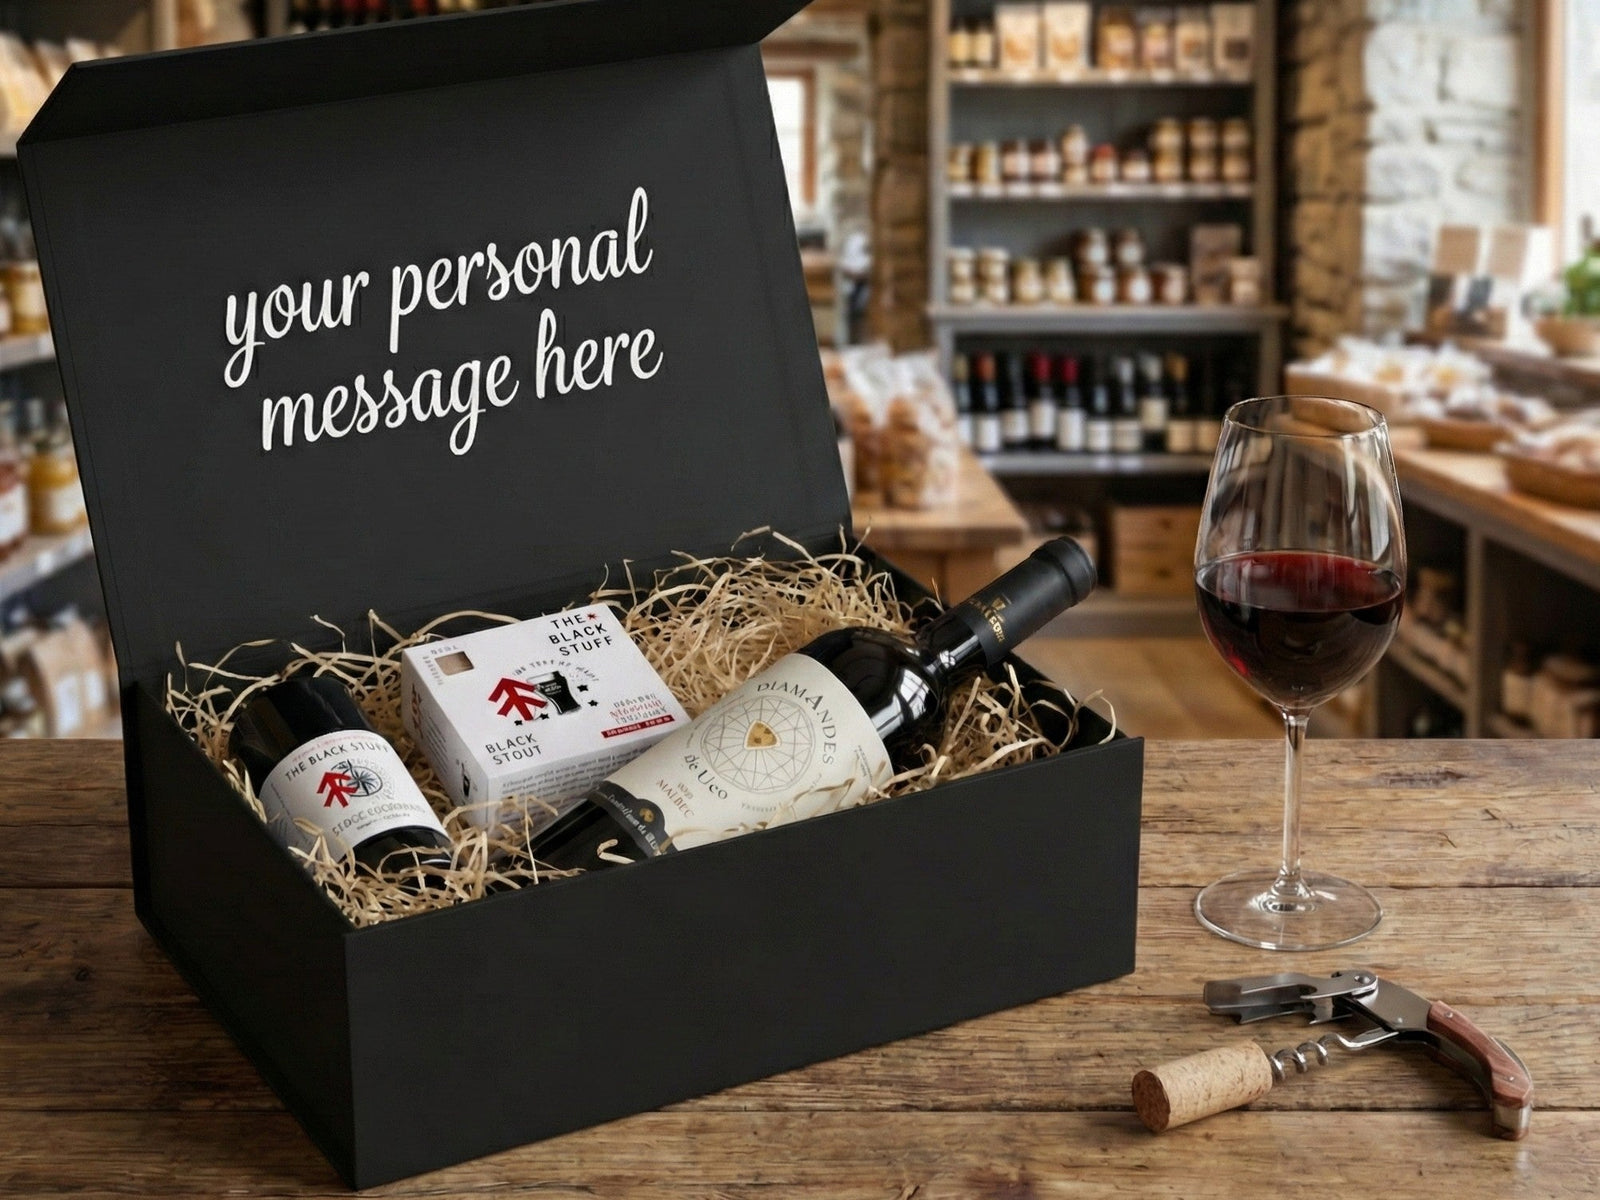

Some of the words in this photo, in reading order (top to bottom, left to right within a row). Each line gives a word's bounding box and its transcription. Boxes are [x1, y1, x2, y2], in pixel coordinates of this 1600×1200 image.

[224, 271, 370, 388] your
[389, 186, 653, 354] personal
[262, 354, 520, 455] message
[536, 307, 664, 399] here
[550, 613, 586, 629] THE
[548, 622, 607, 645] BLACK
[559, 635, 613, 656] STUFF
[485, 733, 537, 754] BLACK
[492, 744, 542, 765] STOUT
[285, 760, 307, 783] THE
[308, 745, 348, 766] BLACK
[655, 779, 695, 819] MALBEC
